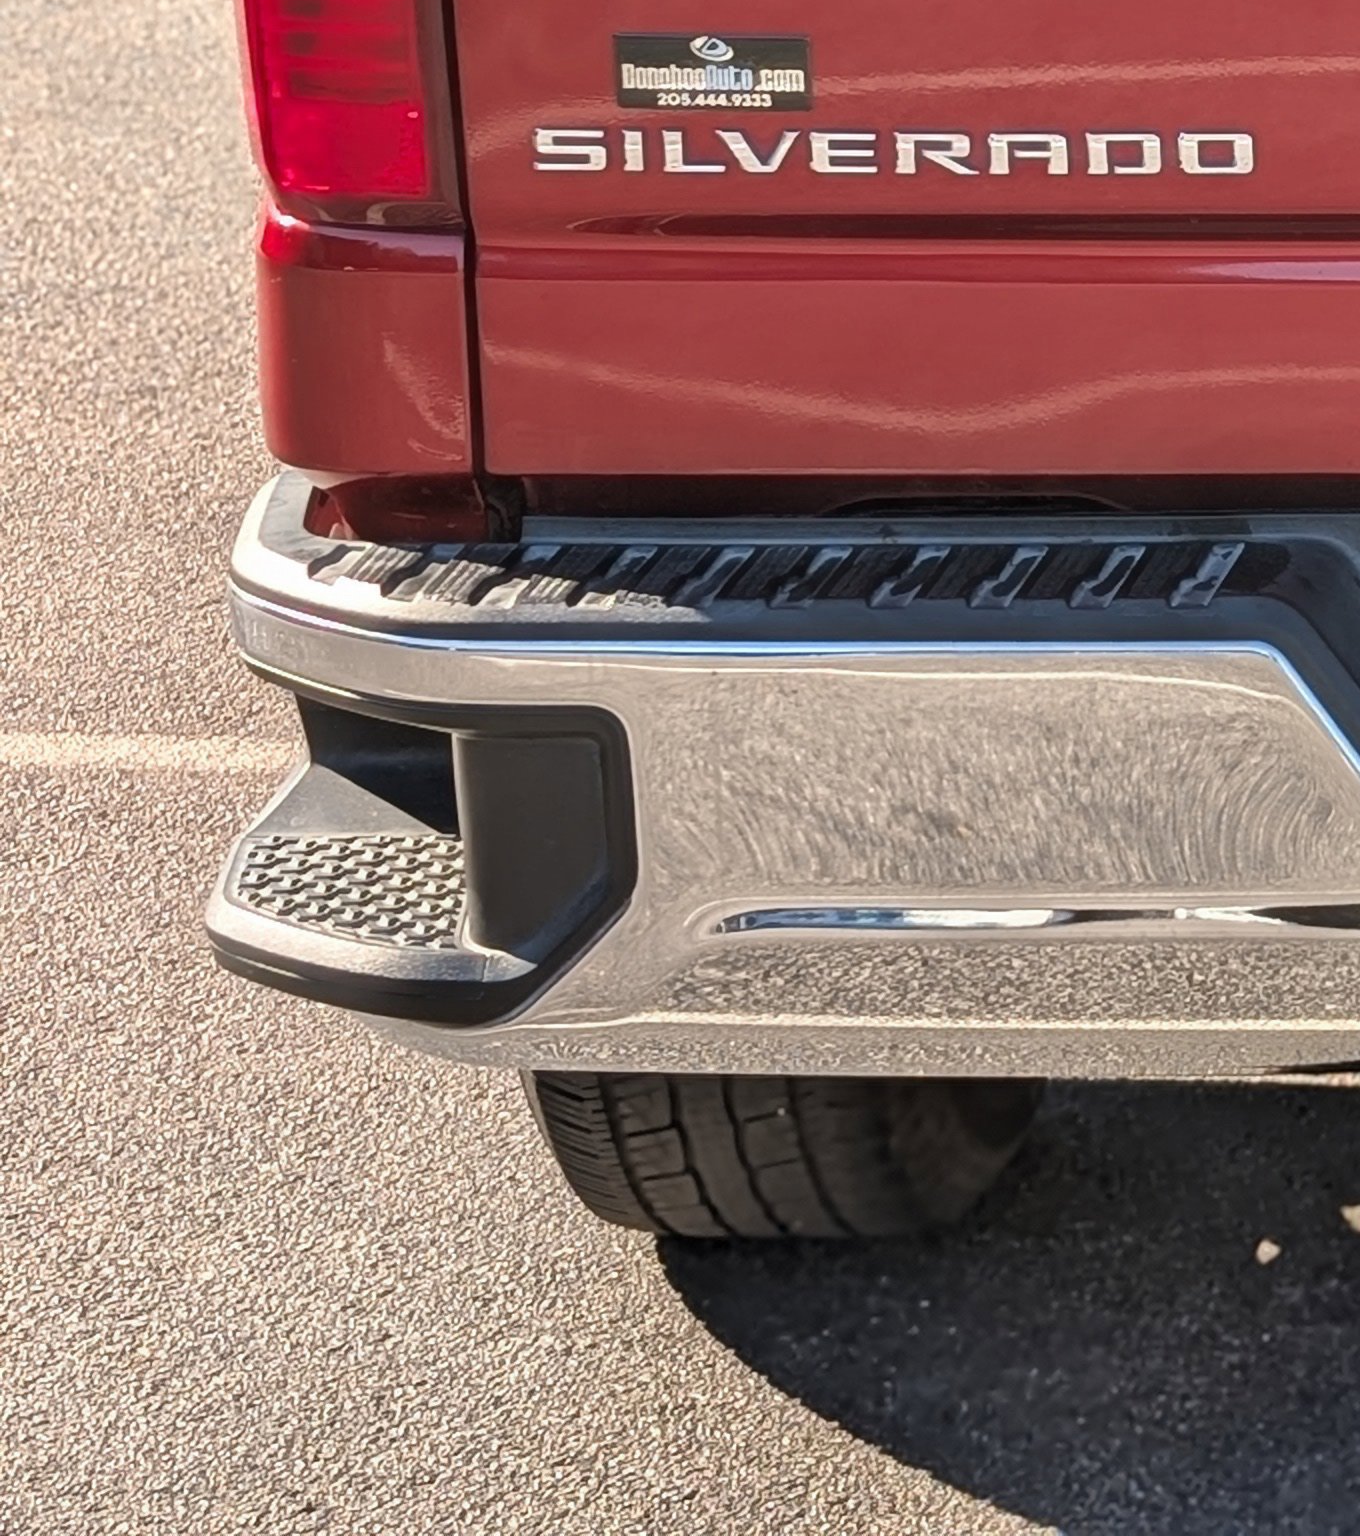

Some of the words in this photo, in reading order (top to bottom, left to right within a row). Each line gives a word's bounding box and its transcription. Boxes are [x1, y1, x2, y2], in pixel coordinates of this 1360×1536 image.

[621, 64, 805, 92] DonohooAuto.com
[657, 92, 772, 108] 205.444.9333
[532, 128, 1254, 174] SILVERADO
